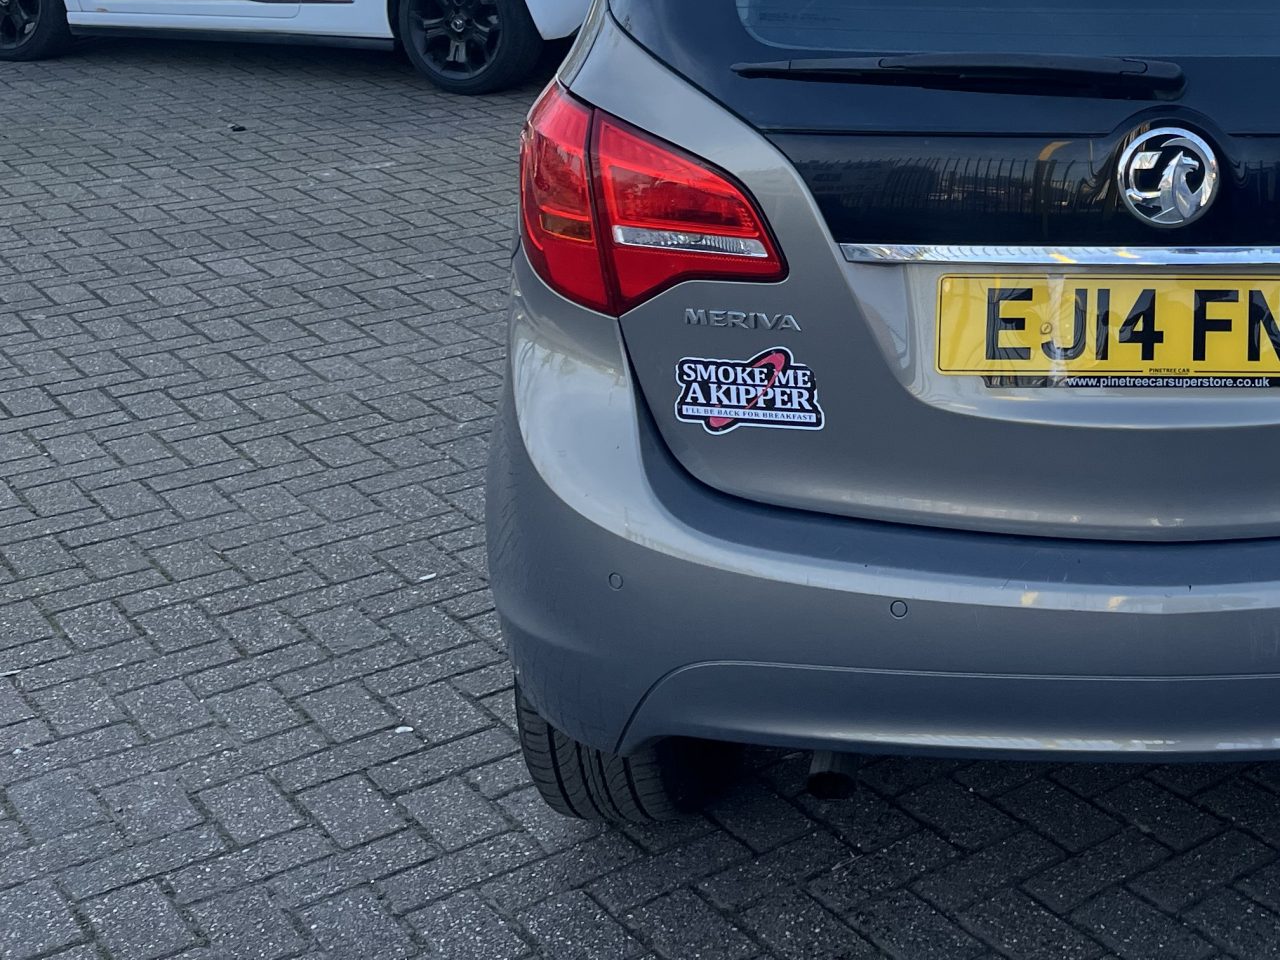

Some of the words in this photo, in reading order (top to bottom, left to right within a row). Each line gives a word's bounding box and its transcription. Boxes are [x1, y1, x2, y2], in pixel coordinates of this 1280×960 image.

[684, 308, 802, 332] MERIVA
[985, 287, 1164, 361] EJ14
[683, 364, 767, 385] SMOKE
[774, 369, 811, 388] ME
[1067, 376, 1270, 388] www.pinetreecarsuperstore.co.uk
[685, 383, 706, 404] A
[709, 384, 813, 410] KIPPER
[717, 409, 740, 417] BACK
[743, 410, 760, 418] FOR
[762, 411, 814, 421] BREAKFAST
